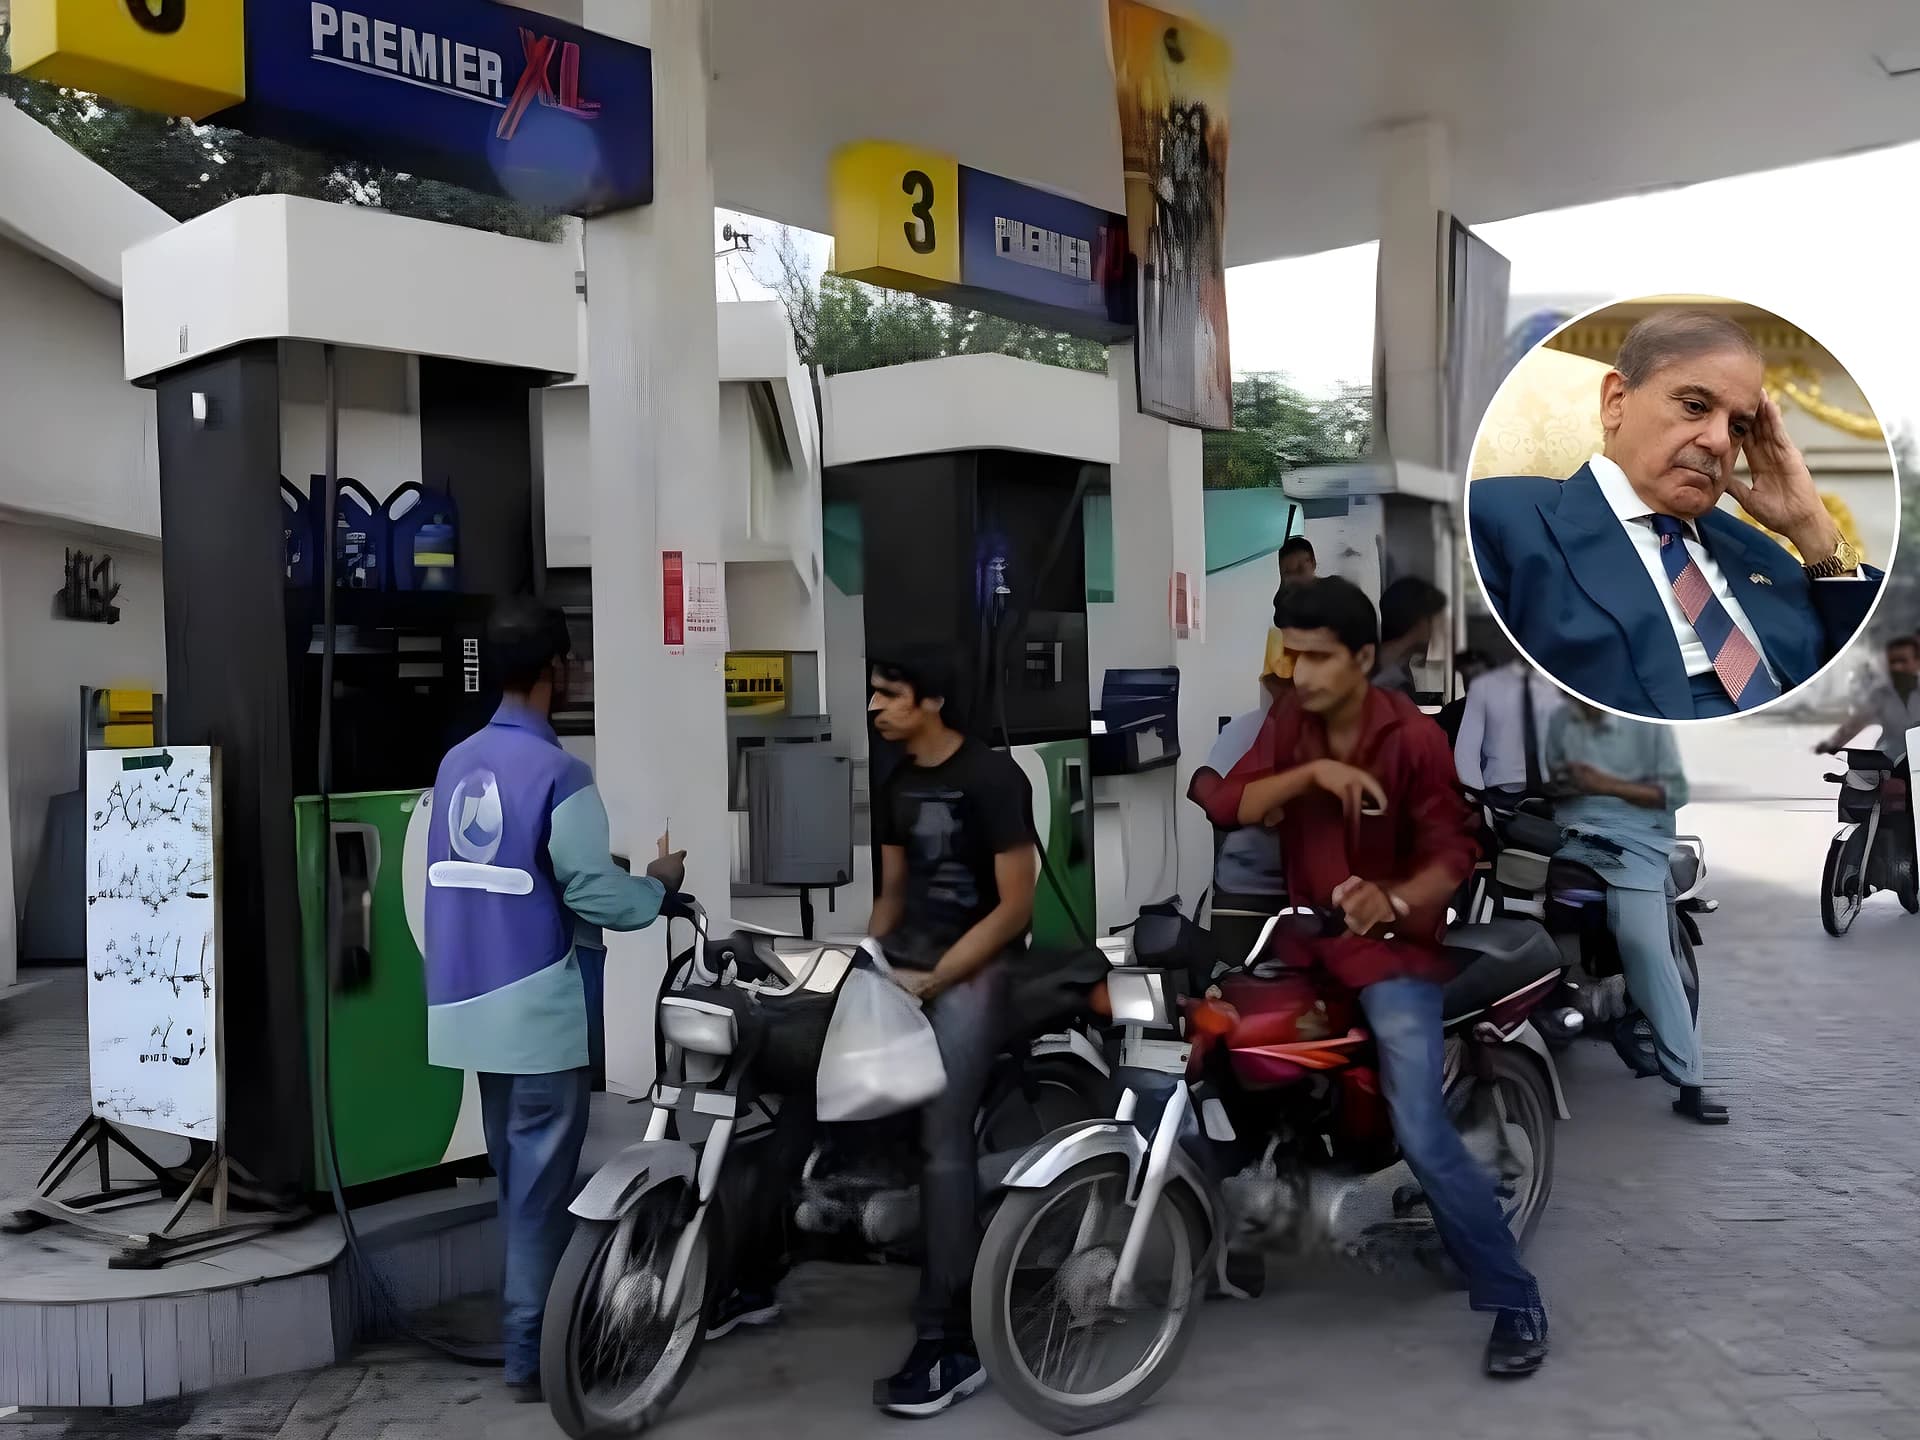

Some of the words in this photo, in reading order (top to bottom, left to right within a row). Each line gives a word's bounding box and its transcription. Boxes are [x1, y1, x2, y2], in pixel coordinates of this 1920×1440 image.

[309, 1, 503, 99] PREMIER
[496, 26, 602, 140] XL
[902, 170, 936, 254] 3
